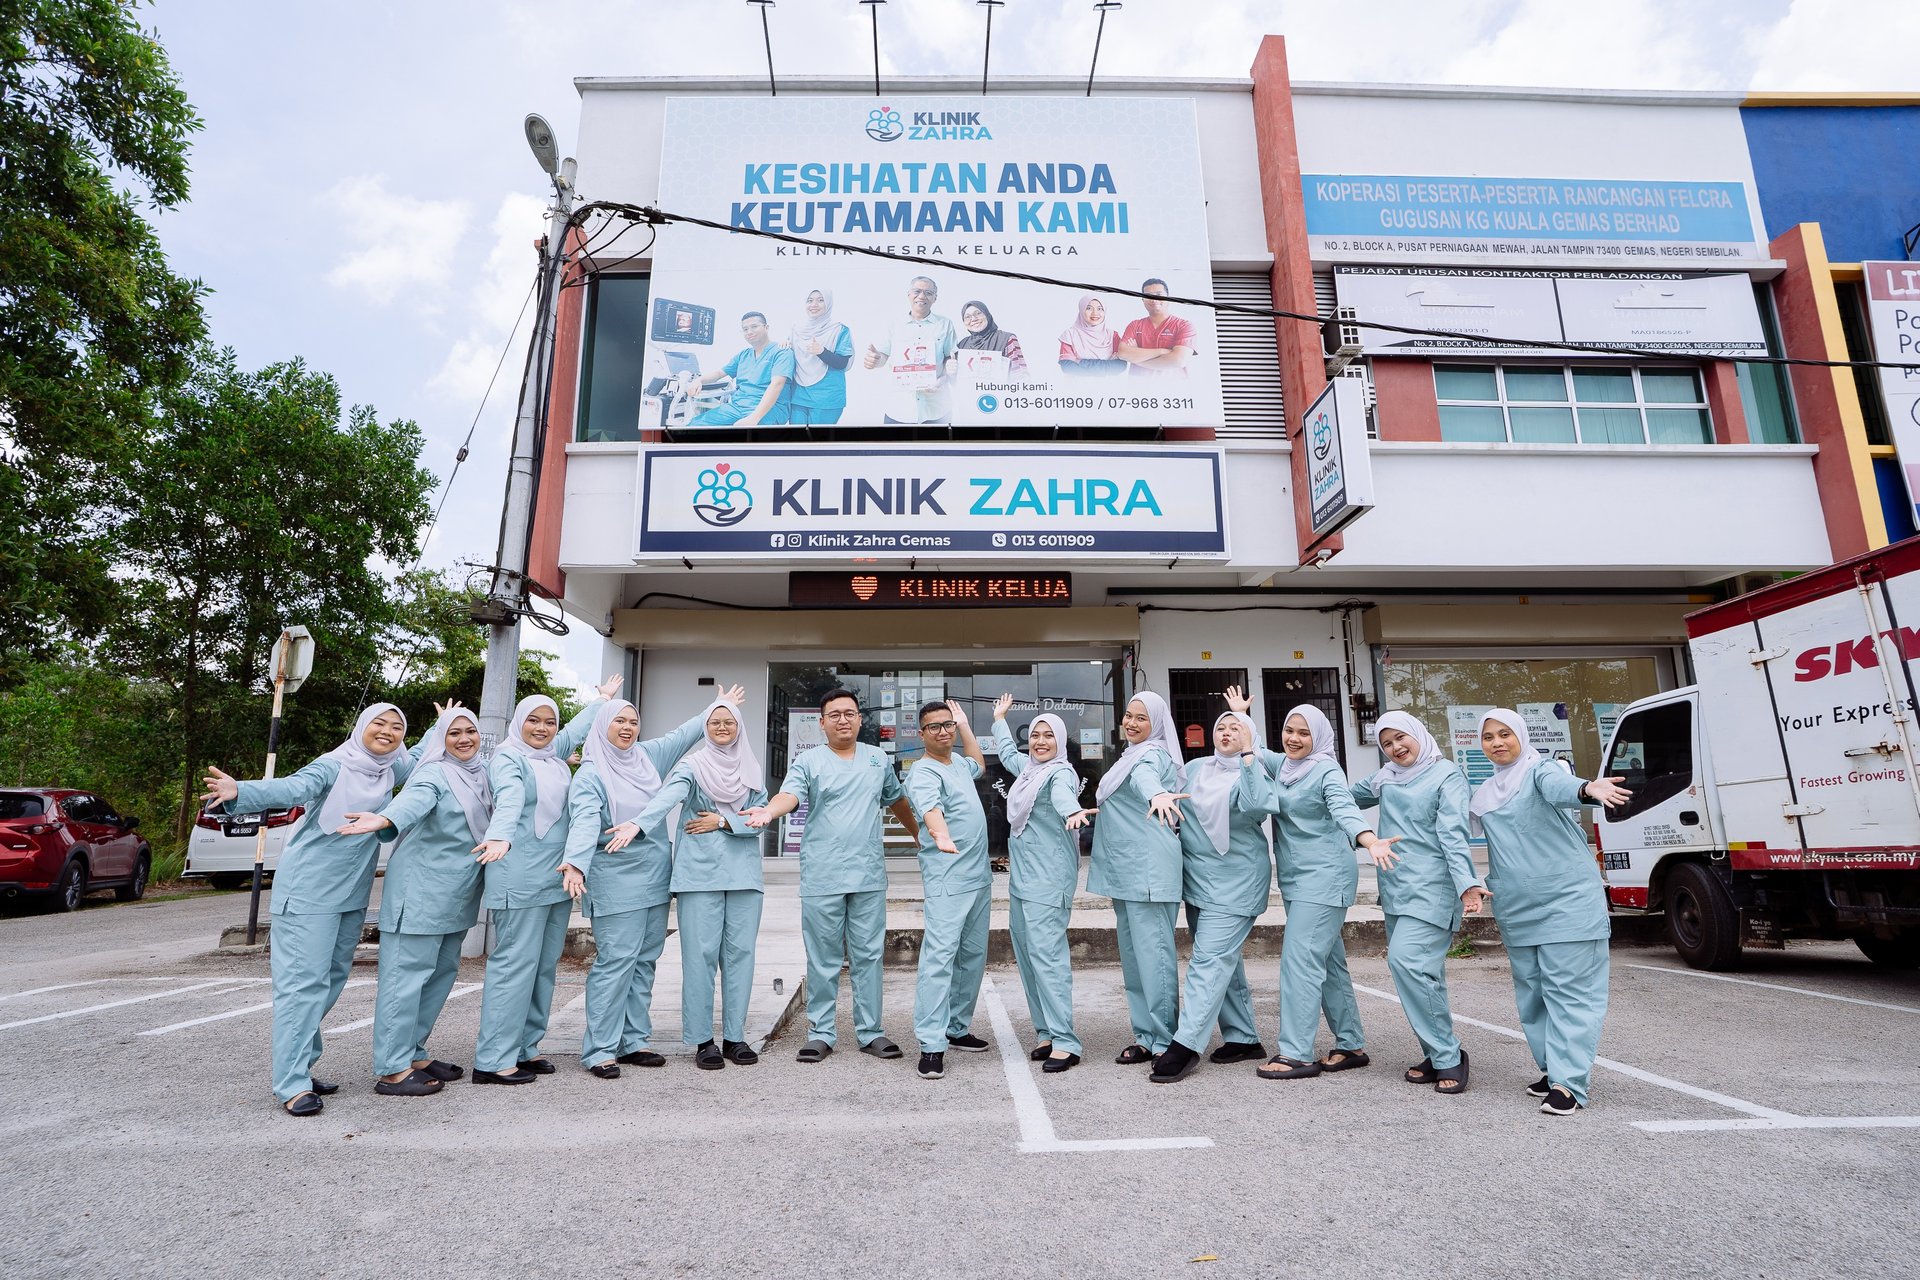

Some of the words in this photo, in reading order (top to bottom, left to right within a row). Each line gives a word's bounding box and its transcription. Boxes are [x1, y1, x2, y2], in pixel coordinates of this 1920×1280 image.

[913, 111, 981, 126] KLINIK
[908, 126, 993, 141] ZAHRA
[744, 162, 987, 195] KESIHATAN
[997, 162, 1117, 195] ANDA
[1316, 182, 1400, 201] KOPERASI
[1406, 183, 1560, 206] PESERTA-PESERTA
[1563, 186, 1666, 208] RANCANGAN
[1669, 188, 1733, 209] FELCRA
[730, 201, 1004, 234] KEUTAMAAN
[1018, 201, 1129, 234] KAMI
[1380, 208, 1462, 229] GUGUSAN
[1466, 210, 1490, 230] KG
[1493, 210, 1550, 231] KUALA
[1552, 212, 1611, 232] GEMAS
[1613, 213, 1681, 233] BERHAD
[868, 245, 943, 256] MESRA
[957, 245, 1078, 256] KELUARGA
[1324, 241, 1341, 251] NO.
[1353, 241, 1384, 252] BLOCK
[1386, 242, 1396, 252] A,
[1398, 242, 1428, 252] PUSAT
[1429, 243, 1489, 253] PERNIAGAAN
[1492, 244, 1529, 255] MEWAH,
[1530, 244, 1561, 255] JALAN
[1562, 245, 1595, 256] TAMPIN
[1596, 246, 1622, 256] 73400
[1624, 246, 1659, 257] GEMAS,
[1660, 247, 1694, 257] NEGERI
[1695, 247, 1743, 257] SEMBILAN.
[1341, 267, 1403, 275] PEJABAT
[1407, 268, 1469, 277] URUSAN
[1472, 269, 1571, 279] KONTRAKTOR
[1574, 272, 1683, 281] PERLADANGAN
[1886, 268, 1920, 296] LI
[1414, 340, 1427, 348] No.
[1437, 340, 1462, 348] BLOCK
[1607, 342, 1639, 350] TAMPIN,
[1639, 342, 1663, 350] 73400
[1664, 343, 1693, 351] GEMAS,
[1722, 343, 1761, 351] SEMBILAN
[975, 382, 1020, 393] Hubungi
[1022, 382, 1048, 391] kami
[1004, 397, 1094, 409] 013-6011909
[1097, 397, 1103, 410] /
[1108, 397, 1159, 409] 07-968
[1163, 398, 1194, 409] 3311
[1314, 456, 1337, 486] KLINIK
[1314, 475, 1339, 500] ZAHRA
[772, 478, 947, 516] KLINIK
[968, 478, 1163, 517] ZAHRA
[1319, 507, 1327, 520] 013
[808, 534, 850, 547] Klinik
[853, 534, 896, 547] Zahra
[900, 534, 951, 547] Gemas
[1012, 534, 1036, 547] 013
[1038, 534, 1095, 547] 6011909
[900, 579, 980, 598] KLINIK
[988, 579, 1070, 598] KELUA
[1043, 698, 1086, 717] Datang
[1781, 713, 1823, 732] Your
[1800, 774, 1843, 789] Fastest
[1848, 768, 1906, 783] Growing
[1770, 851, 1917, 867] www.skynet.com.my
